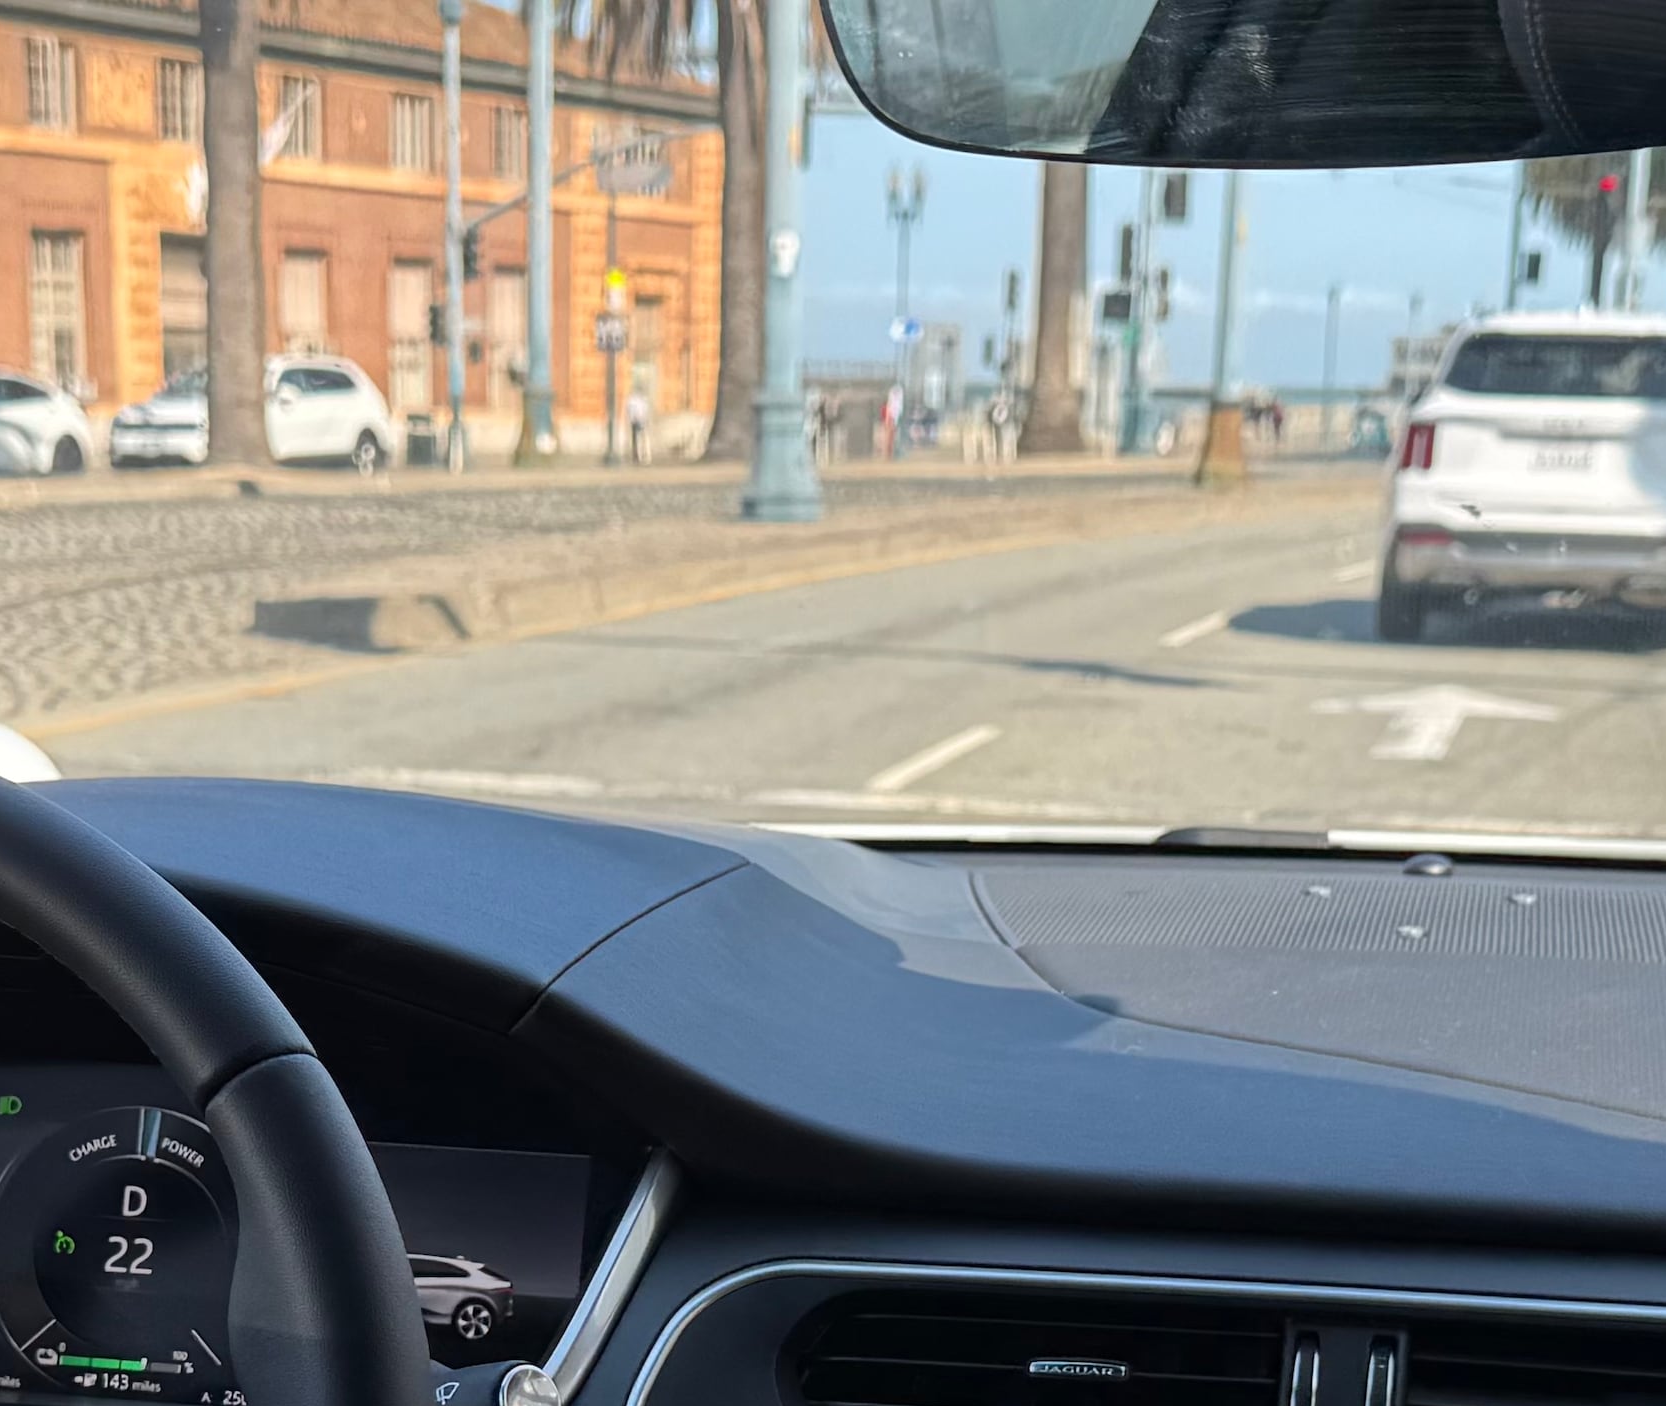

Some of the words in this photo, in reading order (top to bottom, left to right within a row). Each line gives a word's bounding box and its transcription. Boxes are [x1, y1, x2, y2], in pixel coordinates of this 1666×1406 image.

[68, 1134, 118, 1162] CHARGE
[160, 1137, 205, 1168] POWER
[122, 1185, 148, 1217] D
[104, 1235, 154, 1275] 22
[102, 1372, 129, 1391] 143
[132, 1380, 162, 1394] miles
[1034, 1365, 1114, 1376] JAGUAR
